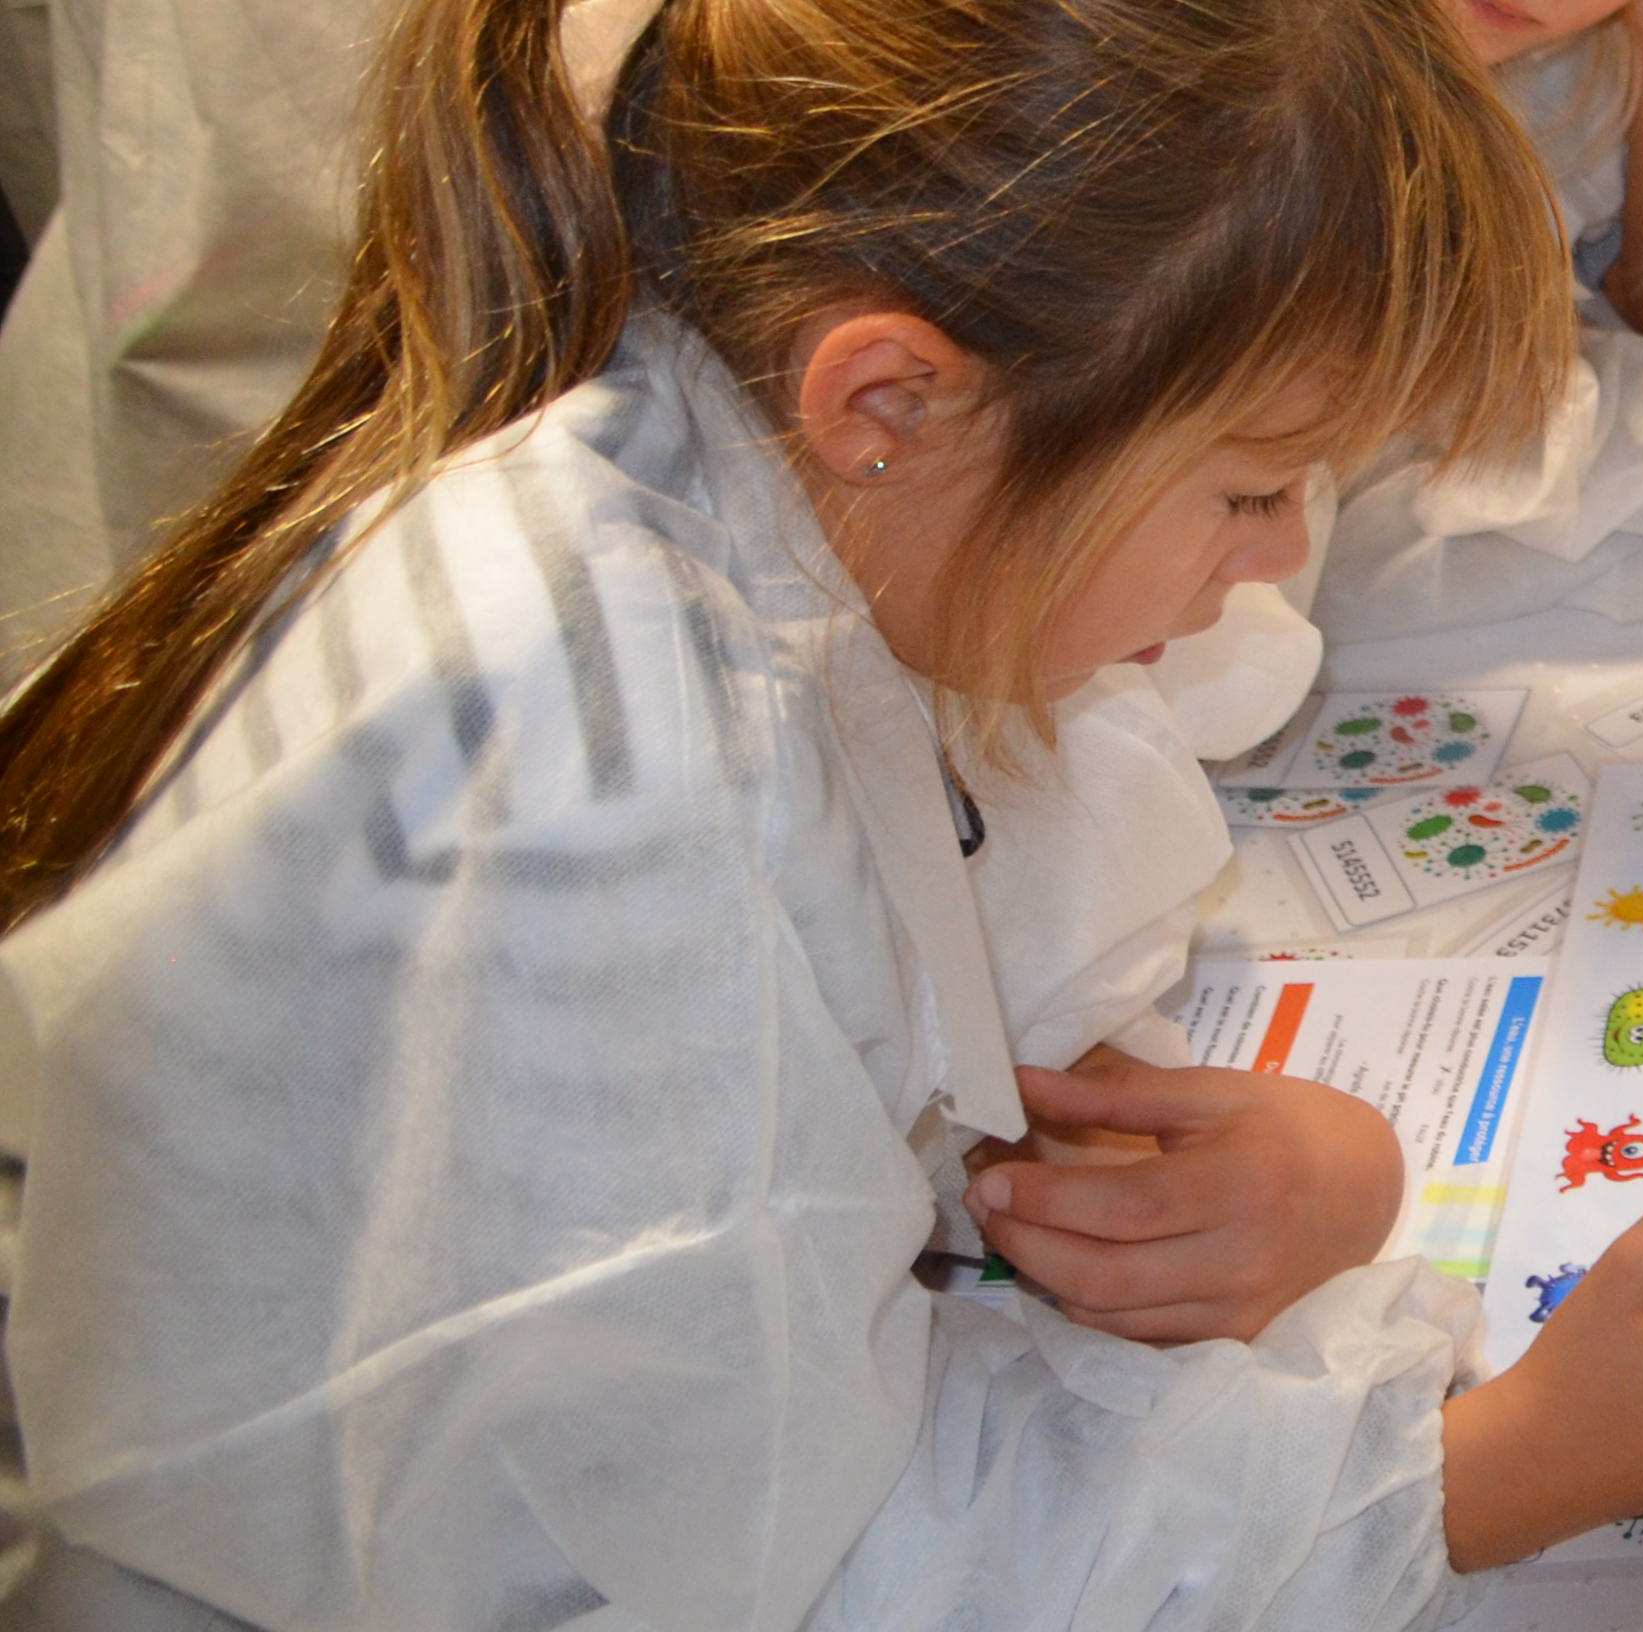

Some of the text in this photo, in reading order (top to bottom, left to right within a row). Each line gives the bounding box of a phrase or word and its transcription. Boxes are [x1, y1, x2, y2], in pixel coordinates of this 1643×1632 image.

[1330, 839, 1381, 902] 5145552
[1483, 1064, 1508, 1110] ressource
[1464, 1119, 1492, 1162] protéger
